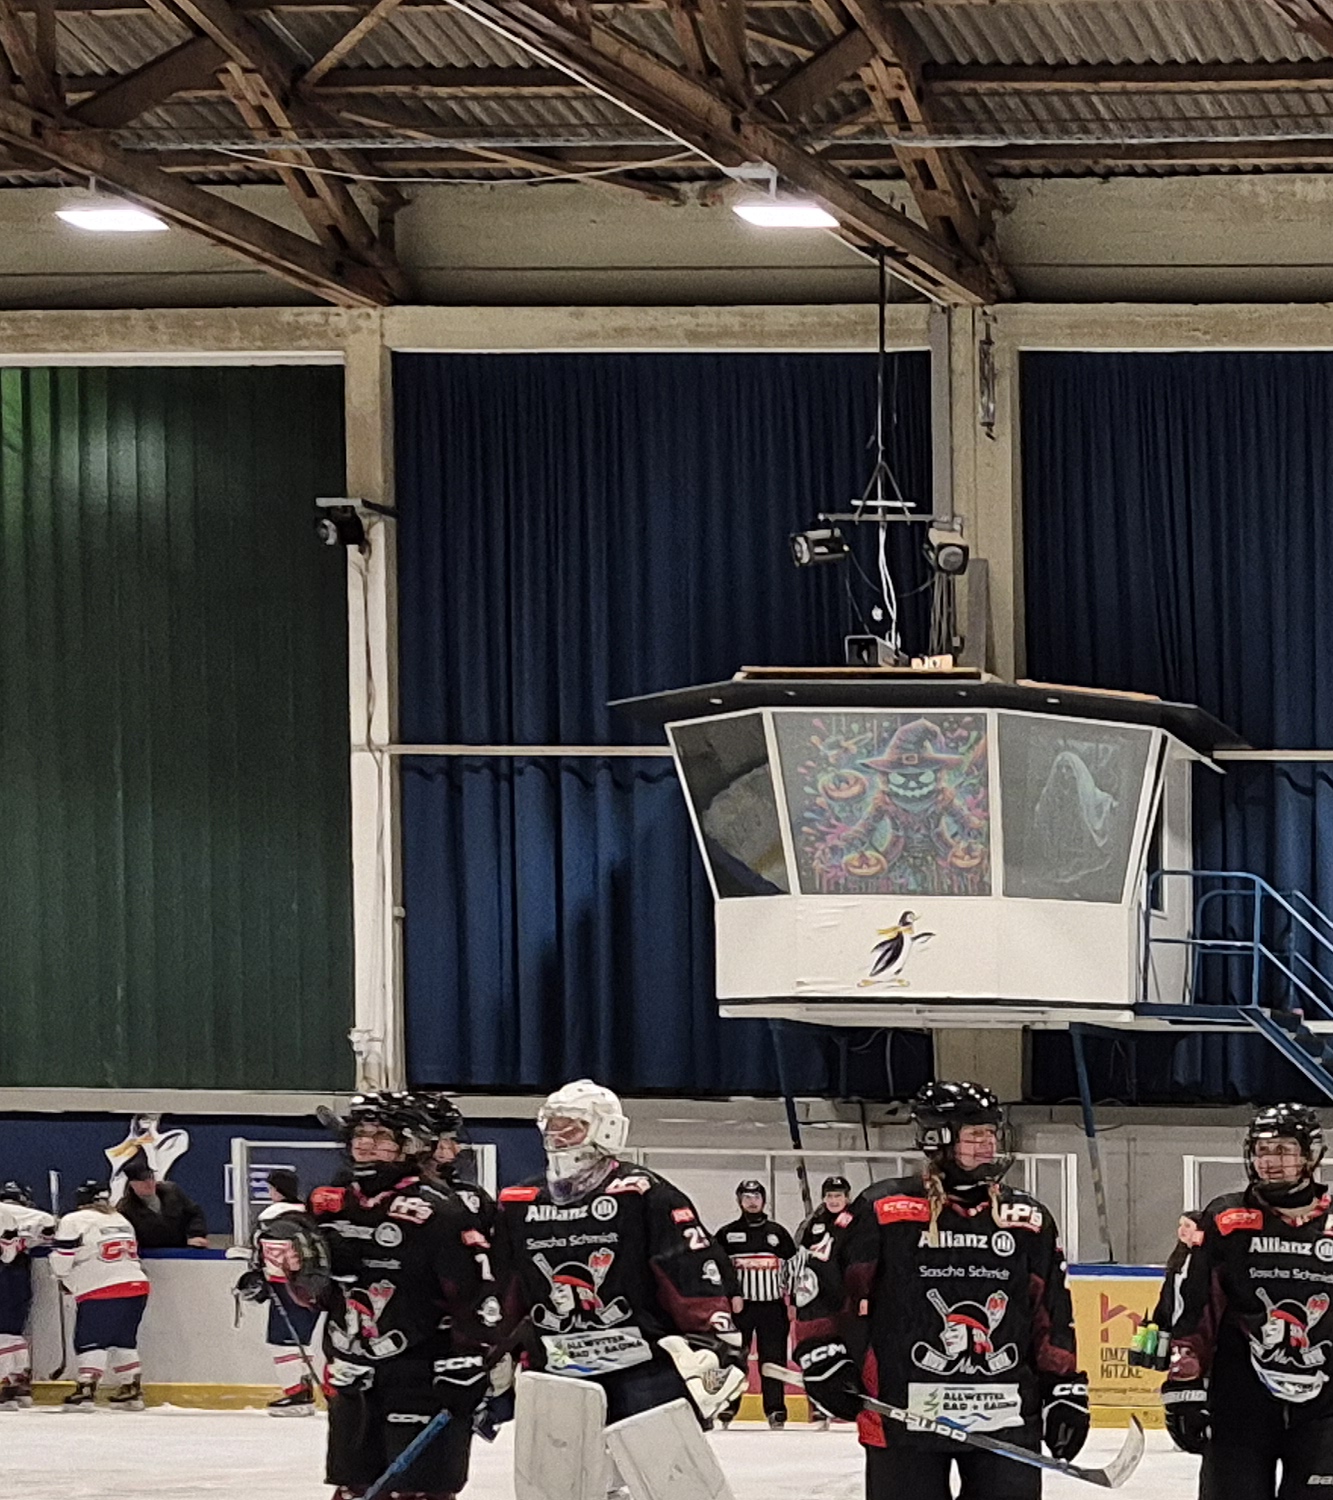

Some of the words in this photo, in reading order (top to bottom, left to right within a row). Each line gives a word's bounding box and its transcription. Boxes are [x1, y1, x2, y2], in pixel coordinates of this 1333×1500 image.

[525, 1204, 589, 1222] Allianz
[1249, 1237, 1313, 1256] Allianz
[919, 1266, 965, 1278] Sascha
[969, 1266, 1010, 1280] Schmidt
[799, 1343, 847, 1369] CCM
